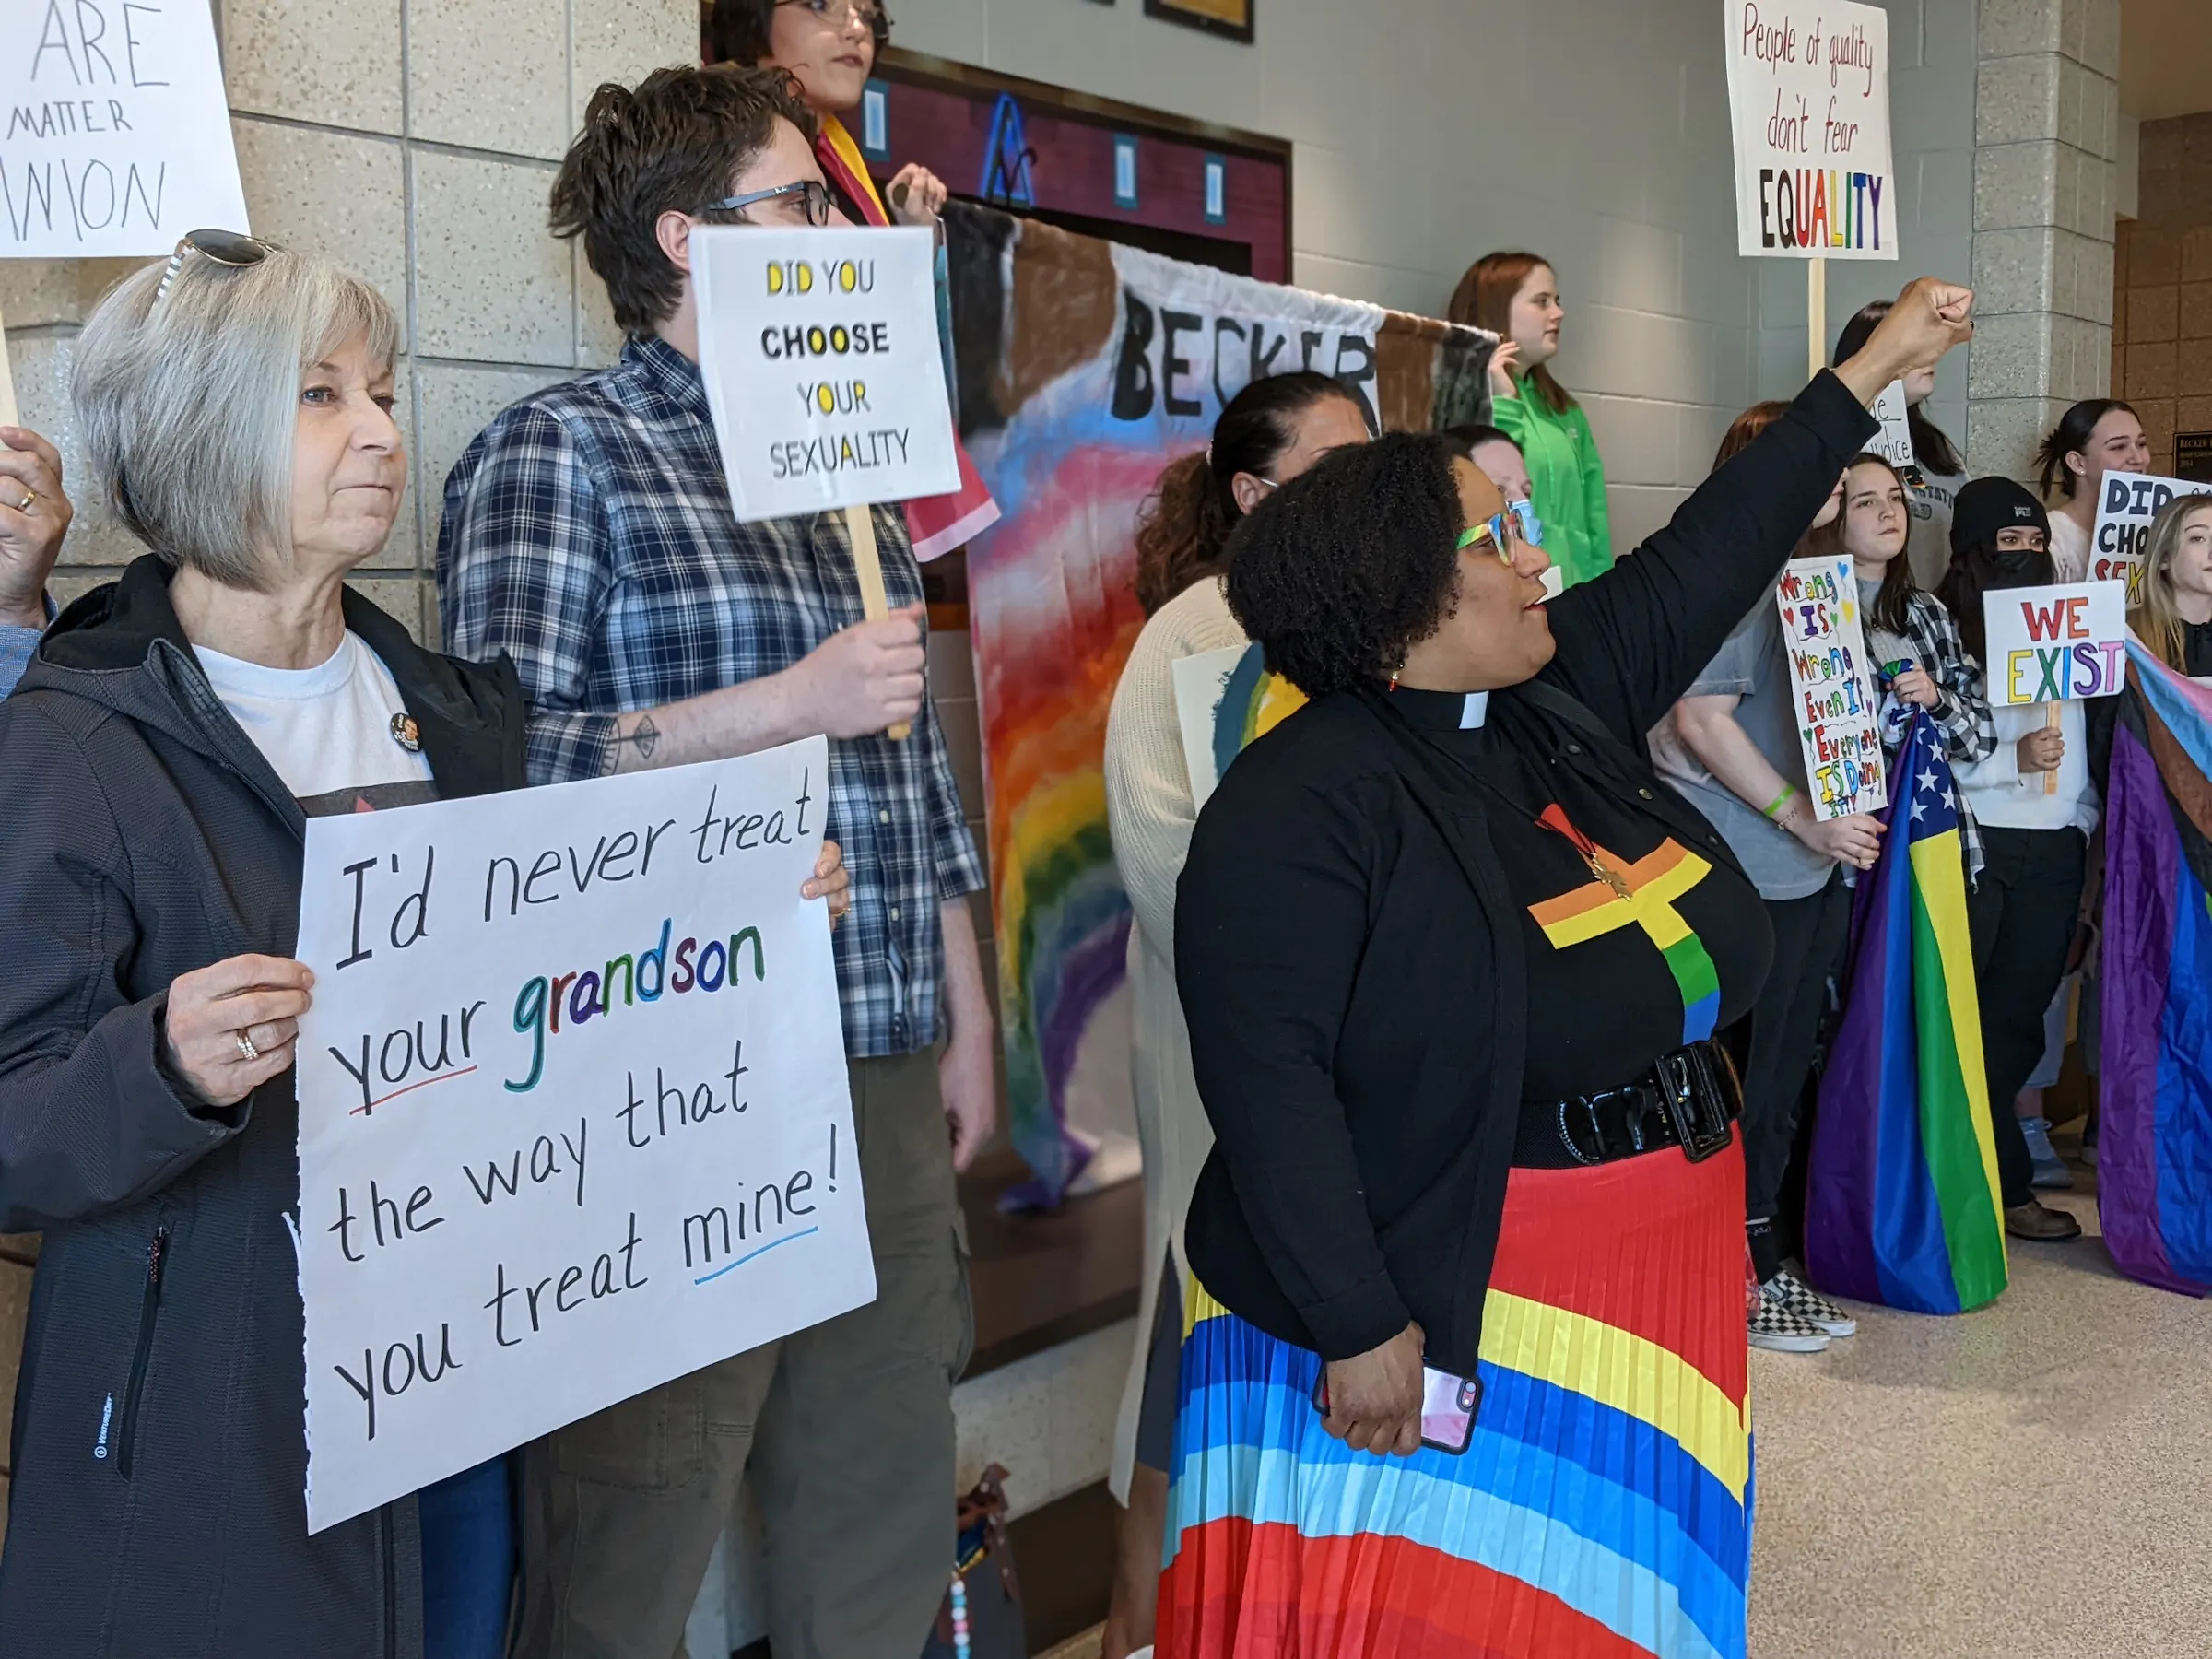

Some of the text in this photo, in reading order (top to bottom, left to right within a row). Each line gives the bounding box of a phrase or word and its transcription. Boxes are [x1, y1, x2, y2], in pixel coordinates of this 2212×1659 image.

[31, 0, 170, 88] ARE
[1743, 2, 1873, 98] People of quality
[7, 99, 133, 140] MATTER
[1767, 87, 1858, 154] don't fear
[1759, 168, 1883, 251] EQUALITY
[766, 259, 875, 297] DID YOU
[760, 322, 890, 359] CHOOSE
[796, 379, 872, 418] YOUR
[769, 428, 910, 479] SEXUALITY
[1779, 568, 1839, 605] Wrong
[2020, 597, 2090, 642] WE
[1791, 646, 1856, 685] Wrong
[2006, 641, 2124, 705] EXIST
[1804, 690, 1846, 724] Even
[1843, 759, 1882, 797] Doing
[335, 766, 812, 971] I'd never treat
[327, 917, 767, 1117] your grandson
[327, 1040, 749, 1263] the way that
[333, 1123, 839, 1441] you treat mine!
